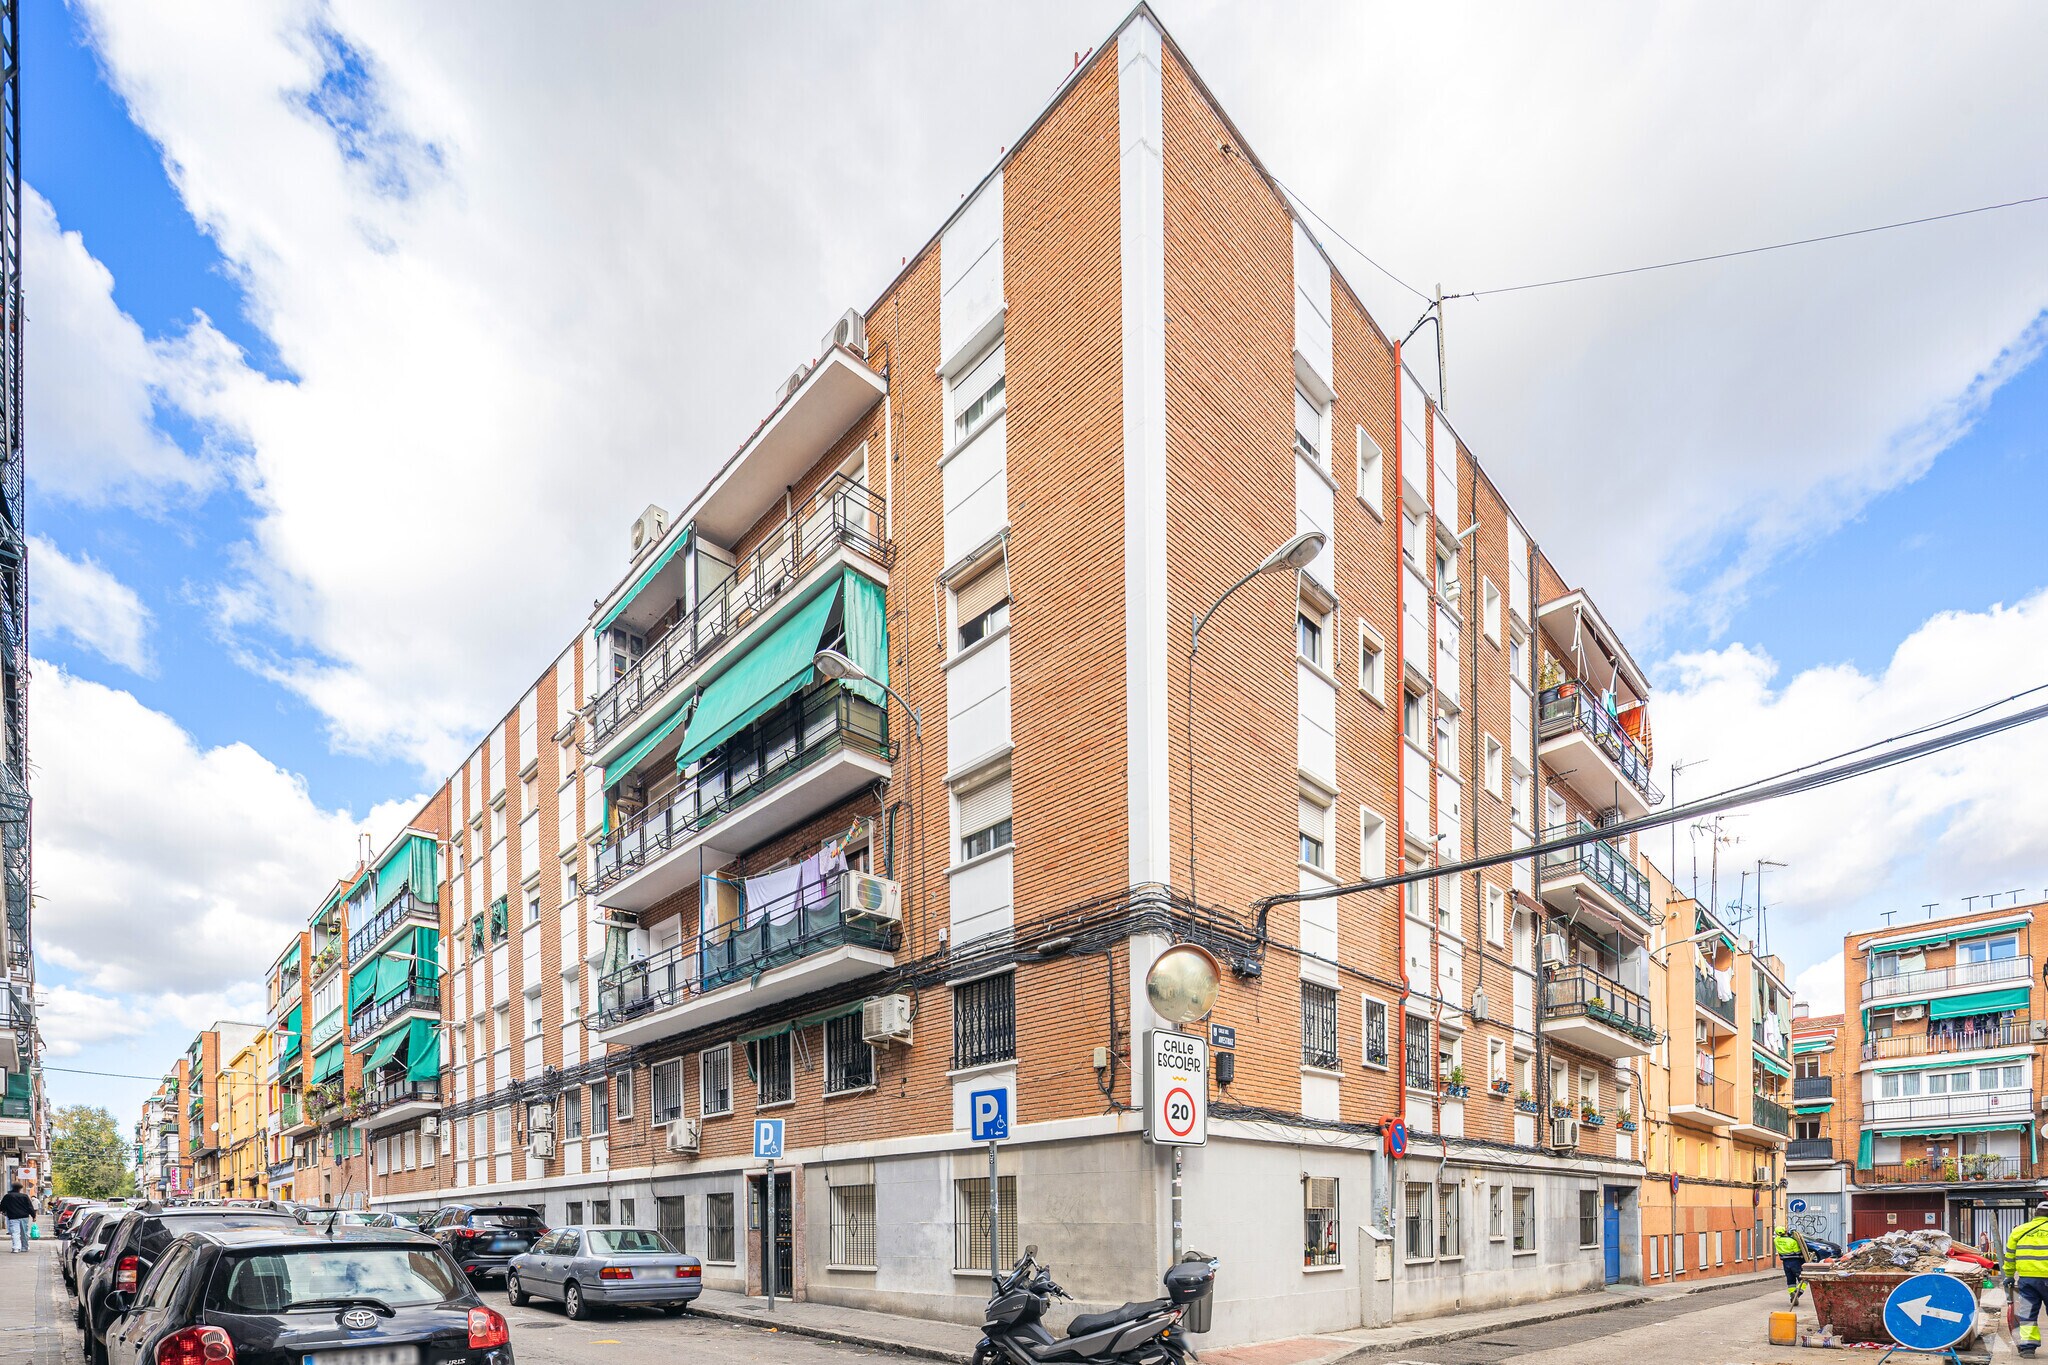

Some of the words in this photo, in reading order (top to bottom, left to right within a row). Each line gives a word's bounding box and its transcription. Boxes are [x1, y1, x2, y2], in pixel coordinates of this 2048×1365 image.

[1158, 1052, 1201, 1073] ESCOLAR
[975, 1094, 999, 1136] P
[1171, 1103, 1189, 1121] 20
[759, 1122, 774, 1155] P
